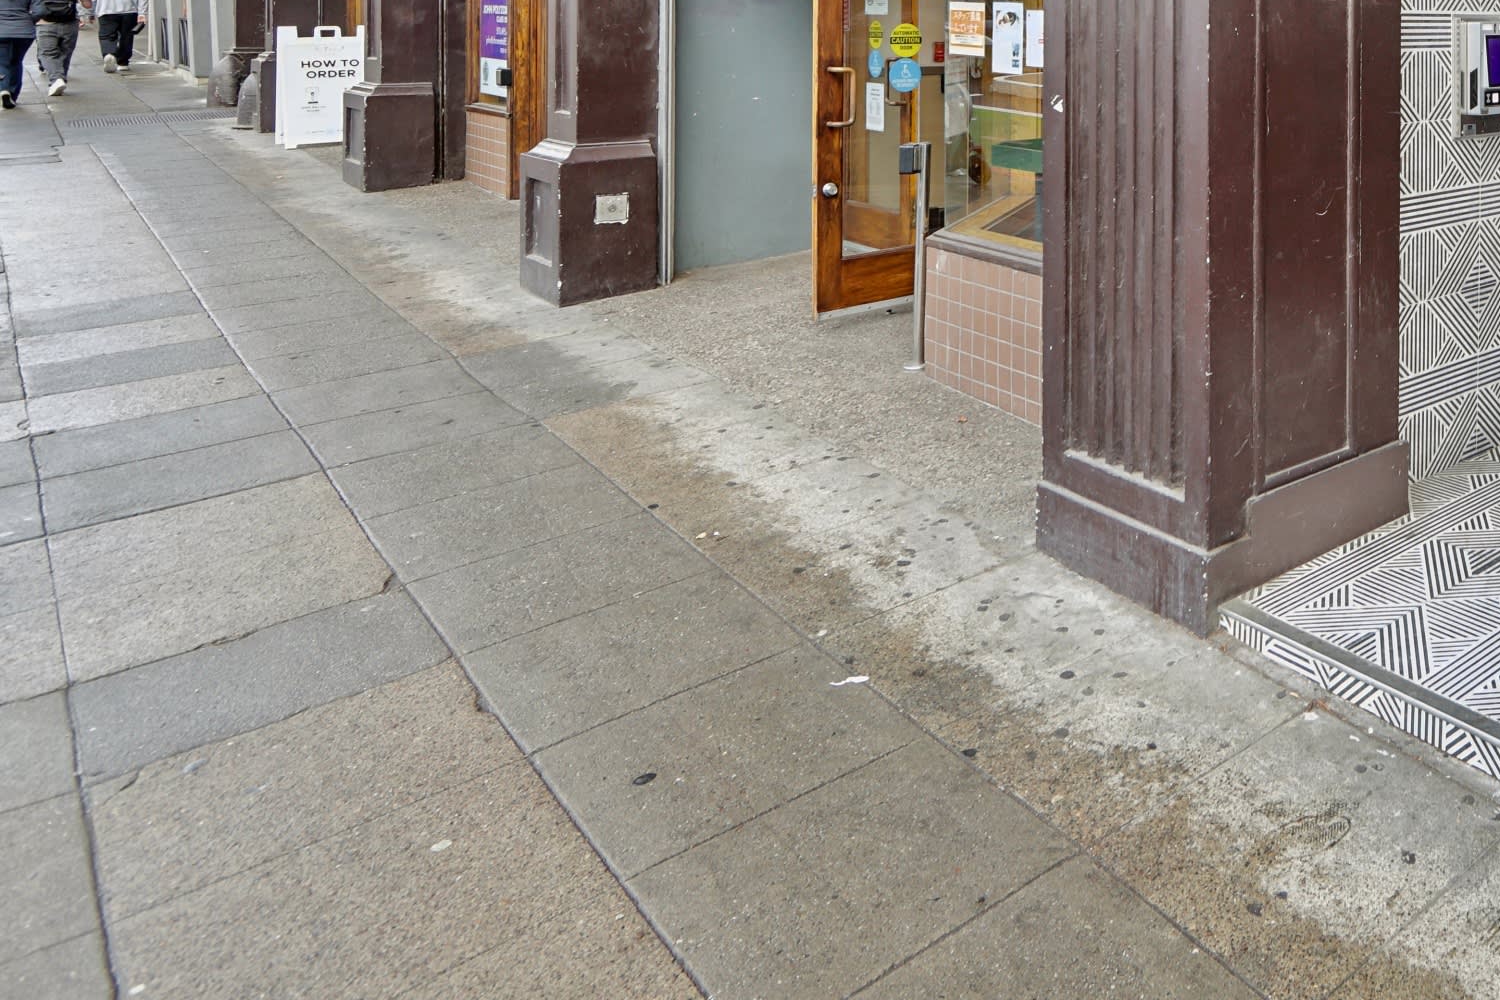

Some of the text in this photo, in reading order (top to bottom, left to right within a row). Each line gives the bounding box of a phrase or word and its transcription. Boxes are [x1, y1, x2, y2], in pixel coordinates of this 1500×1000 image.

[301, 59, 360, 68] HOW TO
[306, 70, 356, 79] ORDER
